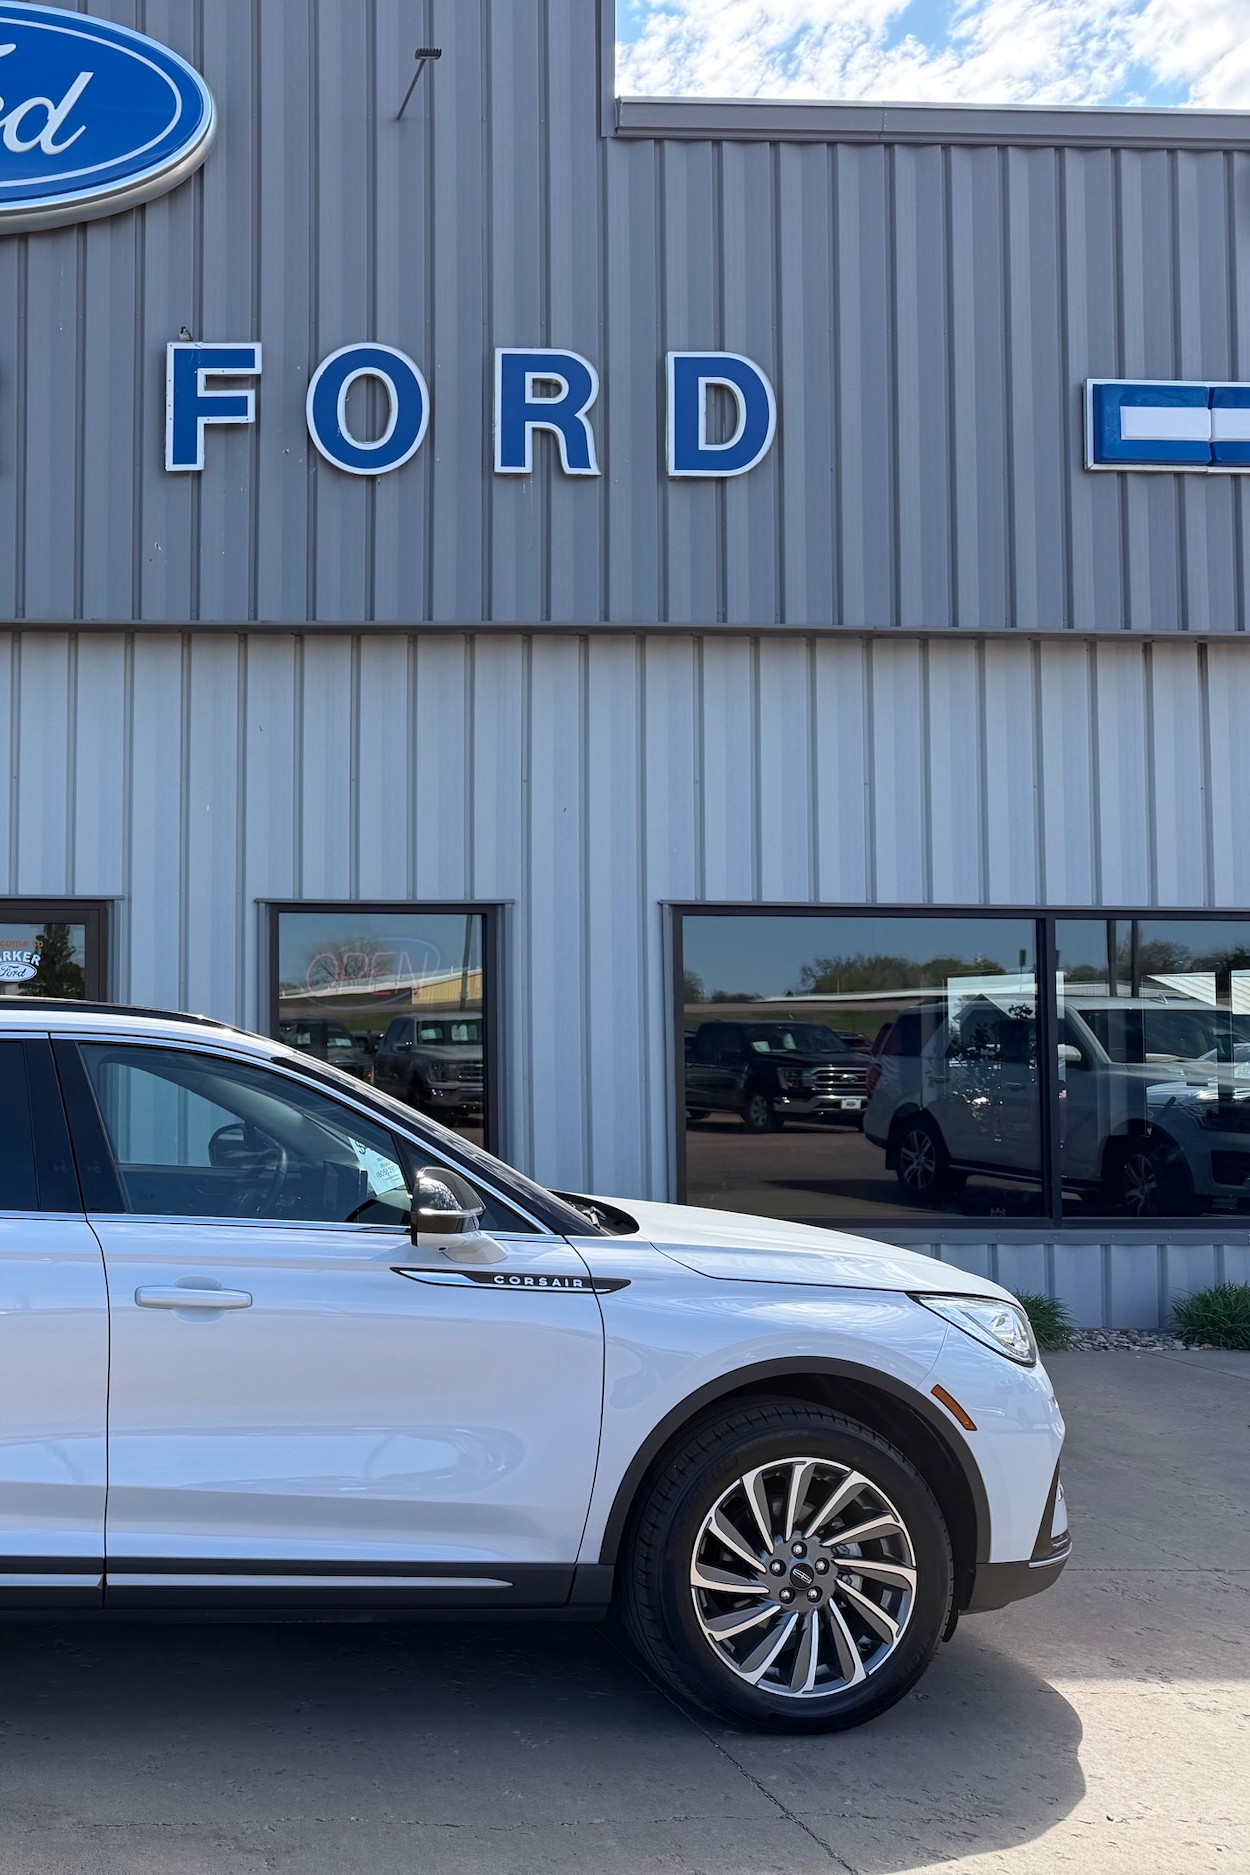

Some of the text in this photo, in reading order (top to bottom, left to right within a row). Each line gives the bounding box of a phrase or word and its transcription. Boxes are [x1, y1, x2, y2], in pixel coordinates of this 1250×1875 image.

[165, 341, 777, 478] FORD
[32, 938, 44, 948] to
[306, 951, 429, 997] OPEN
[493, 1275, 584, 1288] CORSAIR
